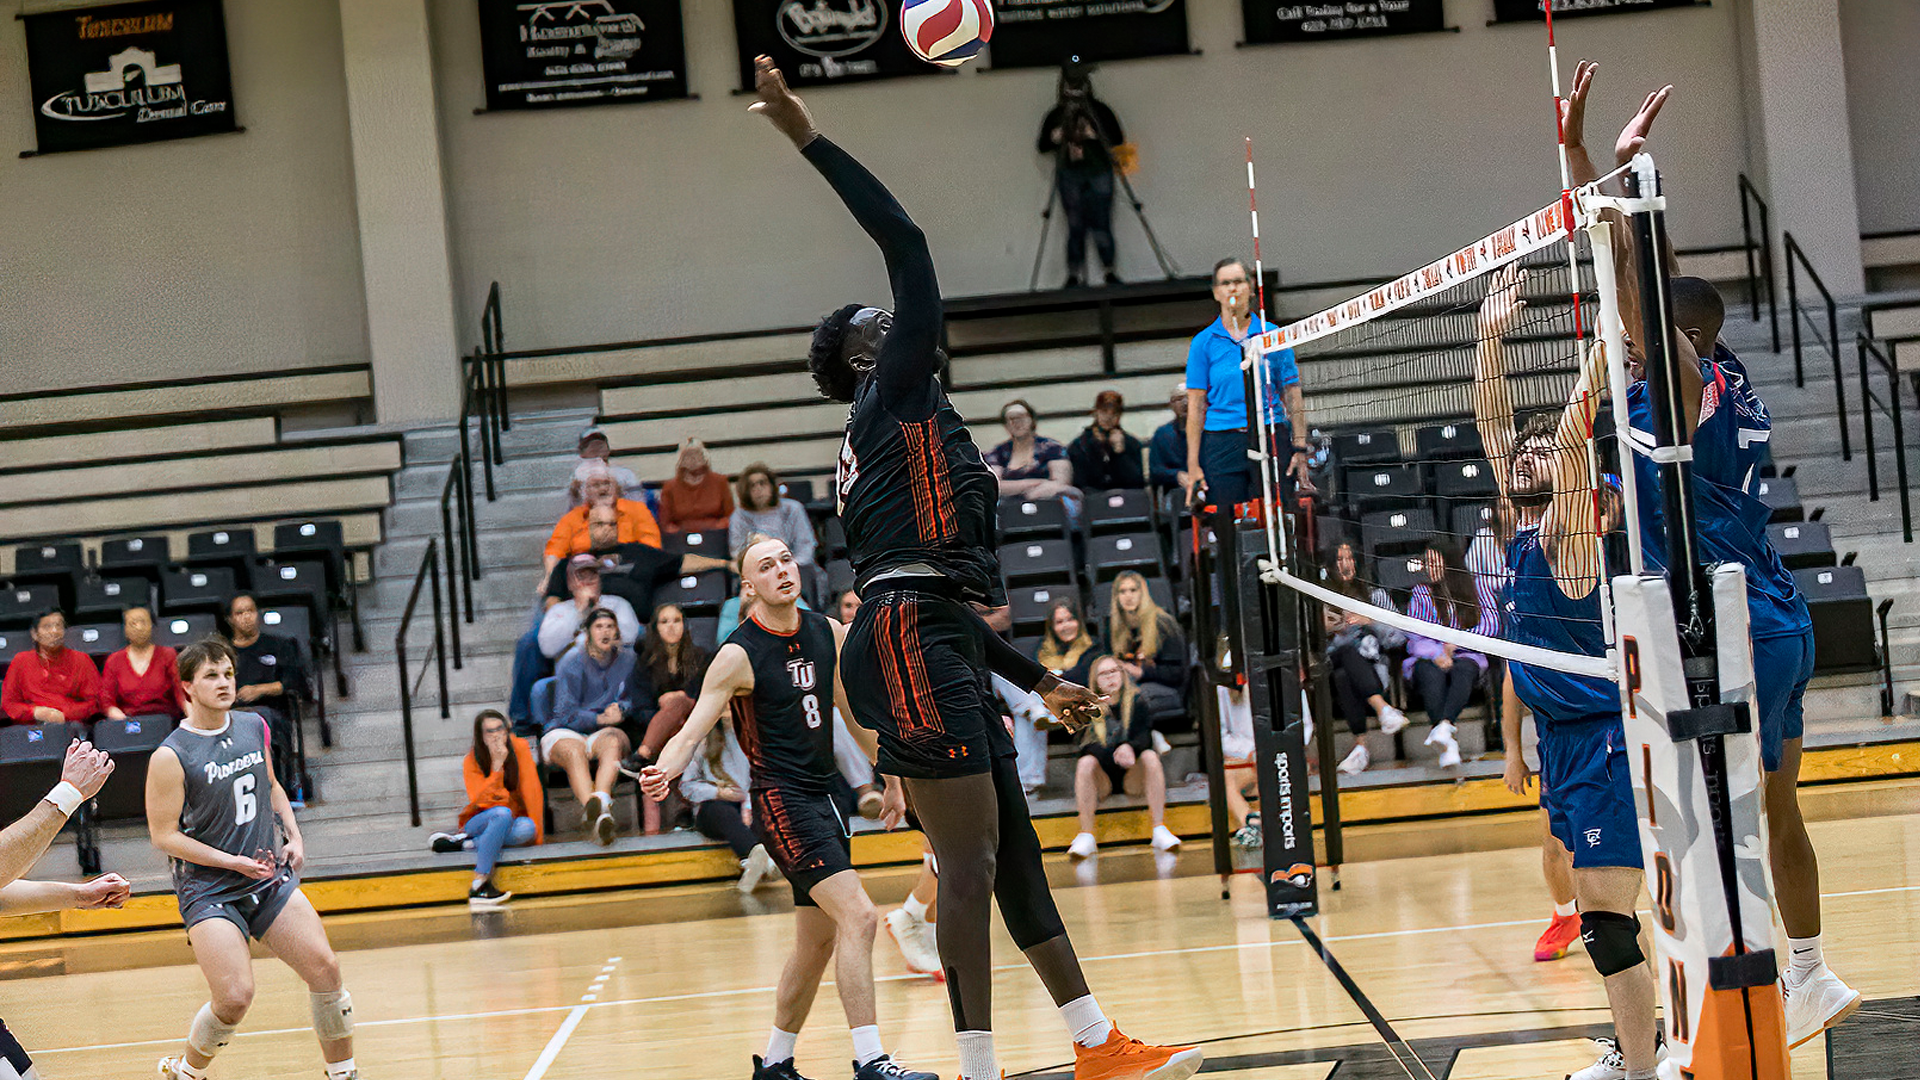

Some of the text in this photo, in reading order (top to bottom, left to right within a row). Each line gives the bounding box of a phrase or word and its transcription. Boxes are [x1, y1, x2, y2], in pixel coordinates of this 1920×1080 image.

[786, 657, 817, 691] TU
[802, 694, 822, 729] 8
[233, 773, 258, 826] 6
[1274, 752, 1296, 850] sports imports
[1623, 634, 1695, 1080] PION
